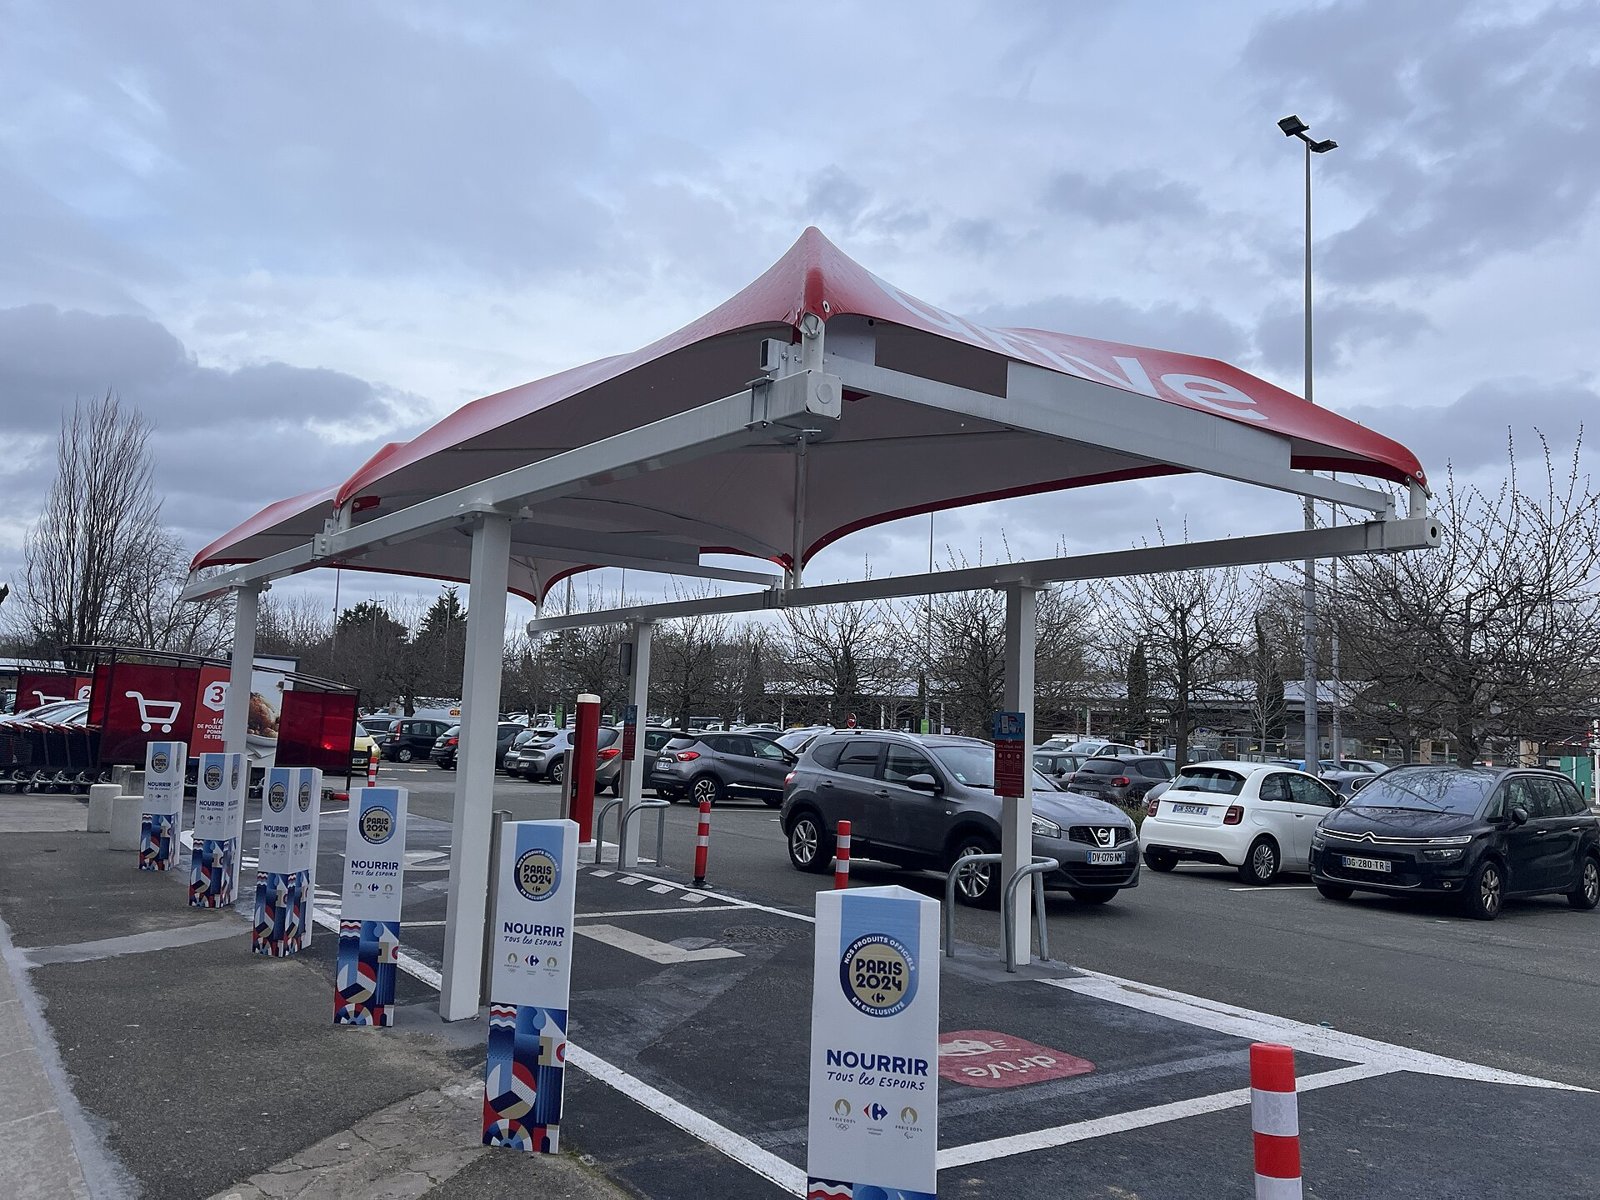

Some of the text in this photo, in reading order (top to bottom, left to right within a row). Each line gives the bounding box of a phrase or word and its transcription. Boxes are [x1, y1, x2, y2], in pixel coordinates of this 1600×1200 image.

[366, 817, 389, 825] PARIS
[263, 824, 289, 833] NOURRIR
[366, 824, 389, 832] 2024
[351, 860, 399, 870] NOURRIR
[523, 864, 552, 875] PARIS
[523, 873, 552, 885] 2024
[503, 921, 565, 938] NOURRIR
[503, 935, 563, 947] TOUS les ESPOIRS
[843, 936, 916, 972] NOS PRODUITS OFFICIELS
[855, 958, 903, 976] PARIS
[855, 973, 903, 992] 2024
[851, 996, 862, 1007] EN
[826, 1049, 929, 1077] NOURRIR
[962, 1055, 1057, 1079] drive
[827, 1071, 926, 1091] TOUS les ESPOIRS
